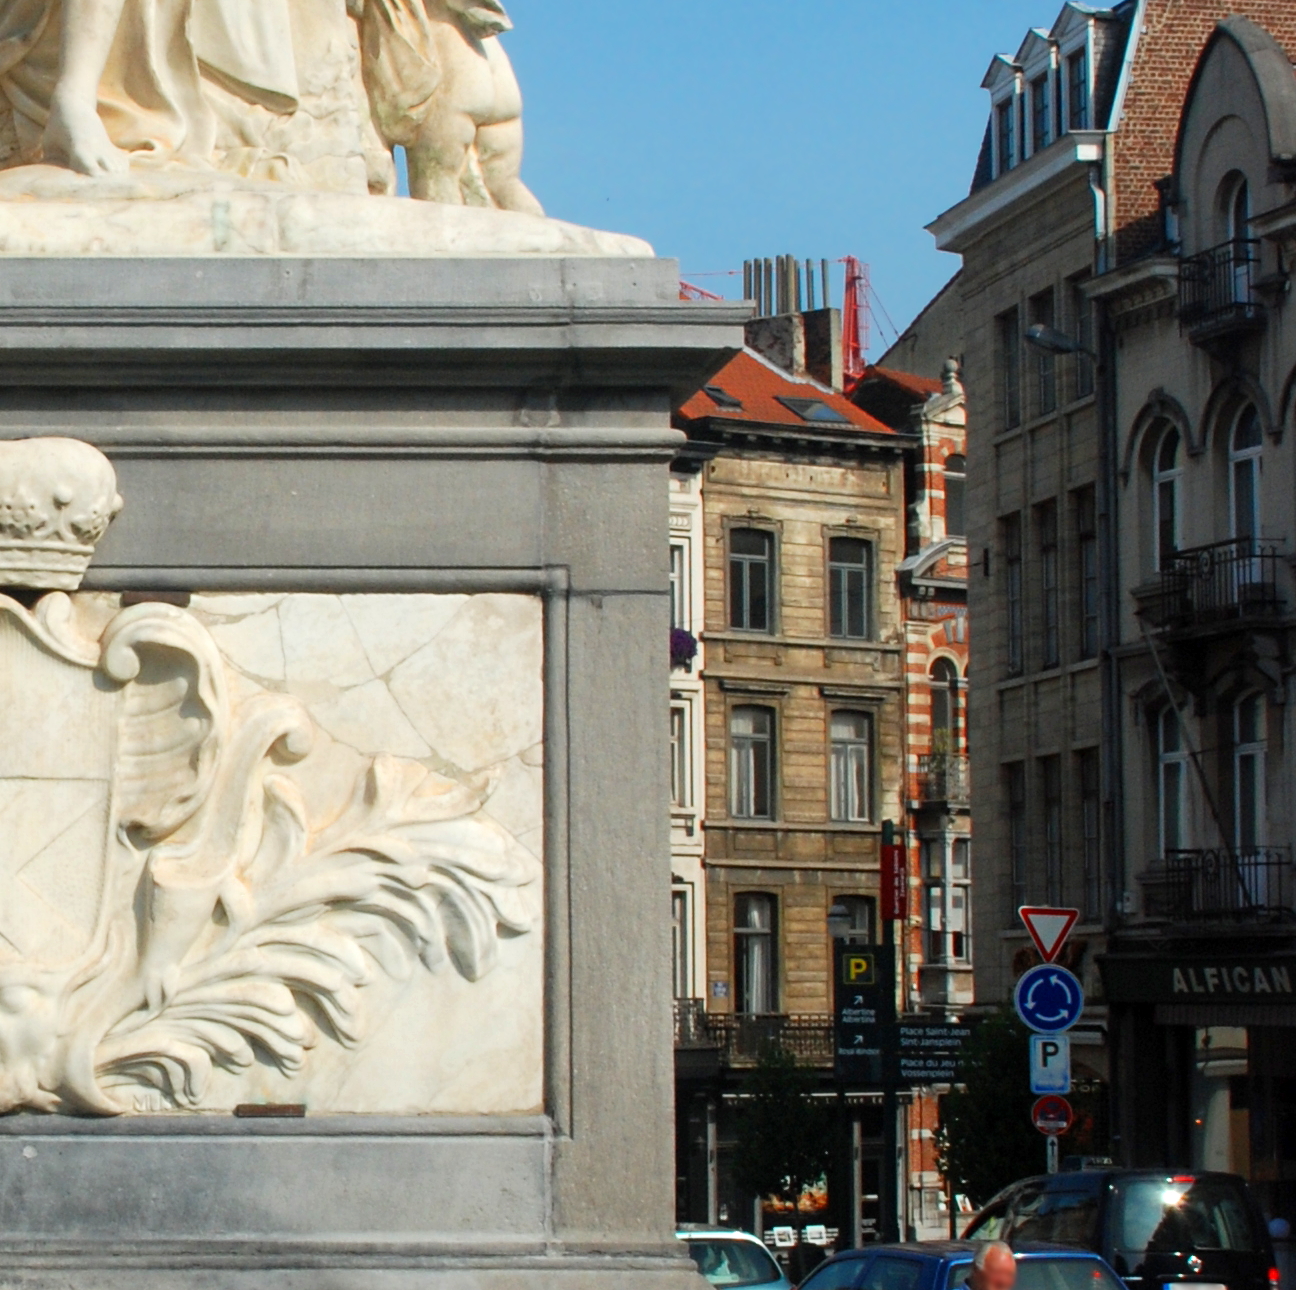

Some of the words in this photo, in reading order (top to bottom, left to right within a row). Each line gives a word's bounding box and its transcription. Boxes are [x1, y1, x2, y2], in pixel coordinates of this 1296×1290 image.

[850, 958, 867, 980] P
[1173, 966, 1292, 993] ALFICAN
[900, 1027, 924, 1036] Place
[925, 1027, 970, 1036] Saint-Jean
[900, 1038, 961, 1047] Sint-Jansplein
[1042, 1042, 1058, 1067] P
[901, 1059, 924, 1067] Place
[926, 1059, 938, 1067] du
[940, 1059, 955, 1067] Jeu
[901, 1068, 954, 1078] Vossenplein
